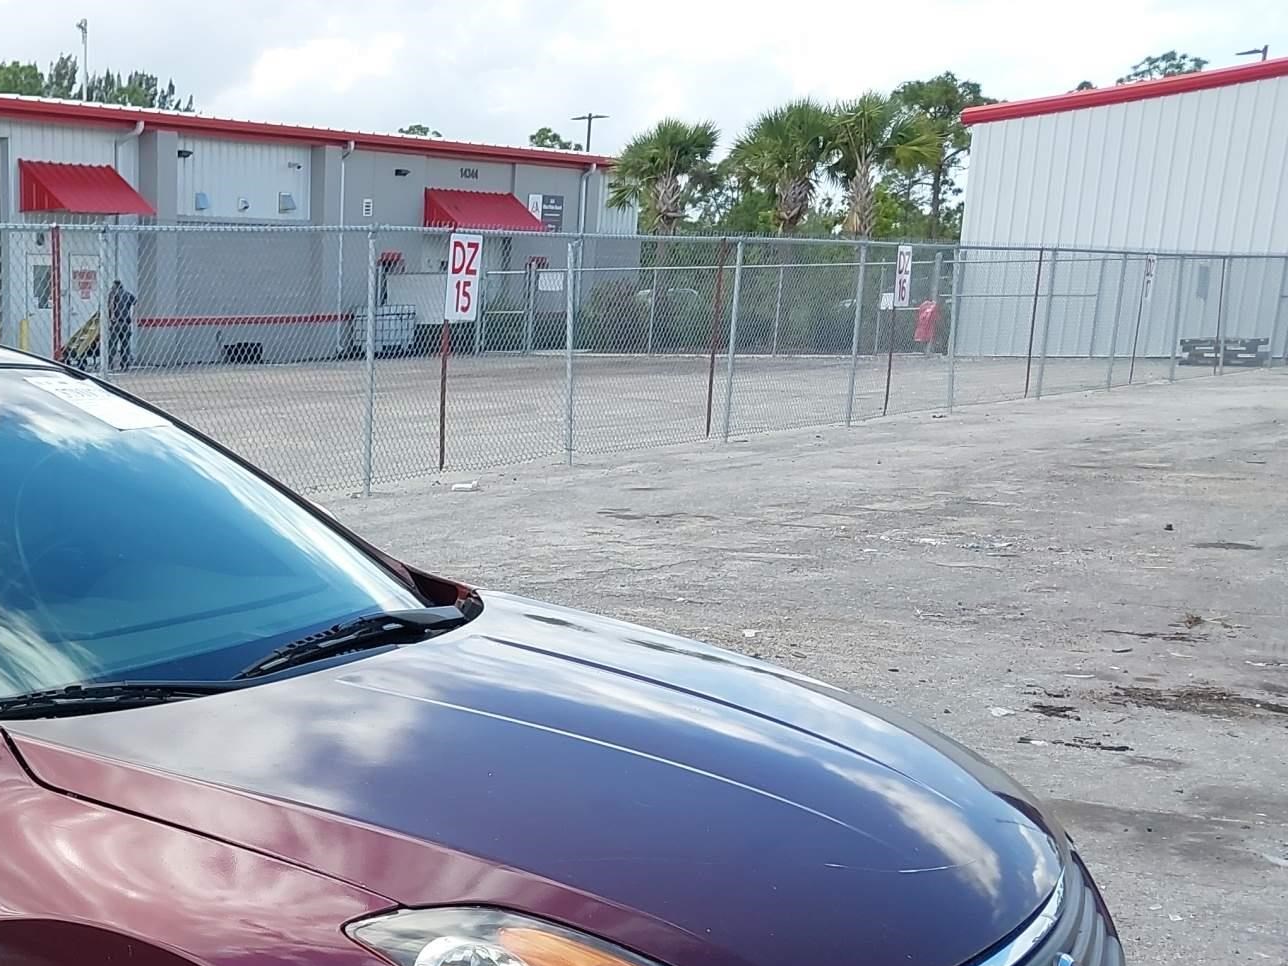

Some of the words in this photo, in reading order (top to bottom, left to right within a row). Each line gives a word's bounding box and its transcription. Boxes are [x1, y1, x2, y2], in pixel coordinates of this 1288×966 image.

[452, 241, 480, 276] DZ
[898, 251, 911, 275] DZ
[455, 280, 472, 313] 15
[898, 278, 907, 302] 16
